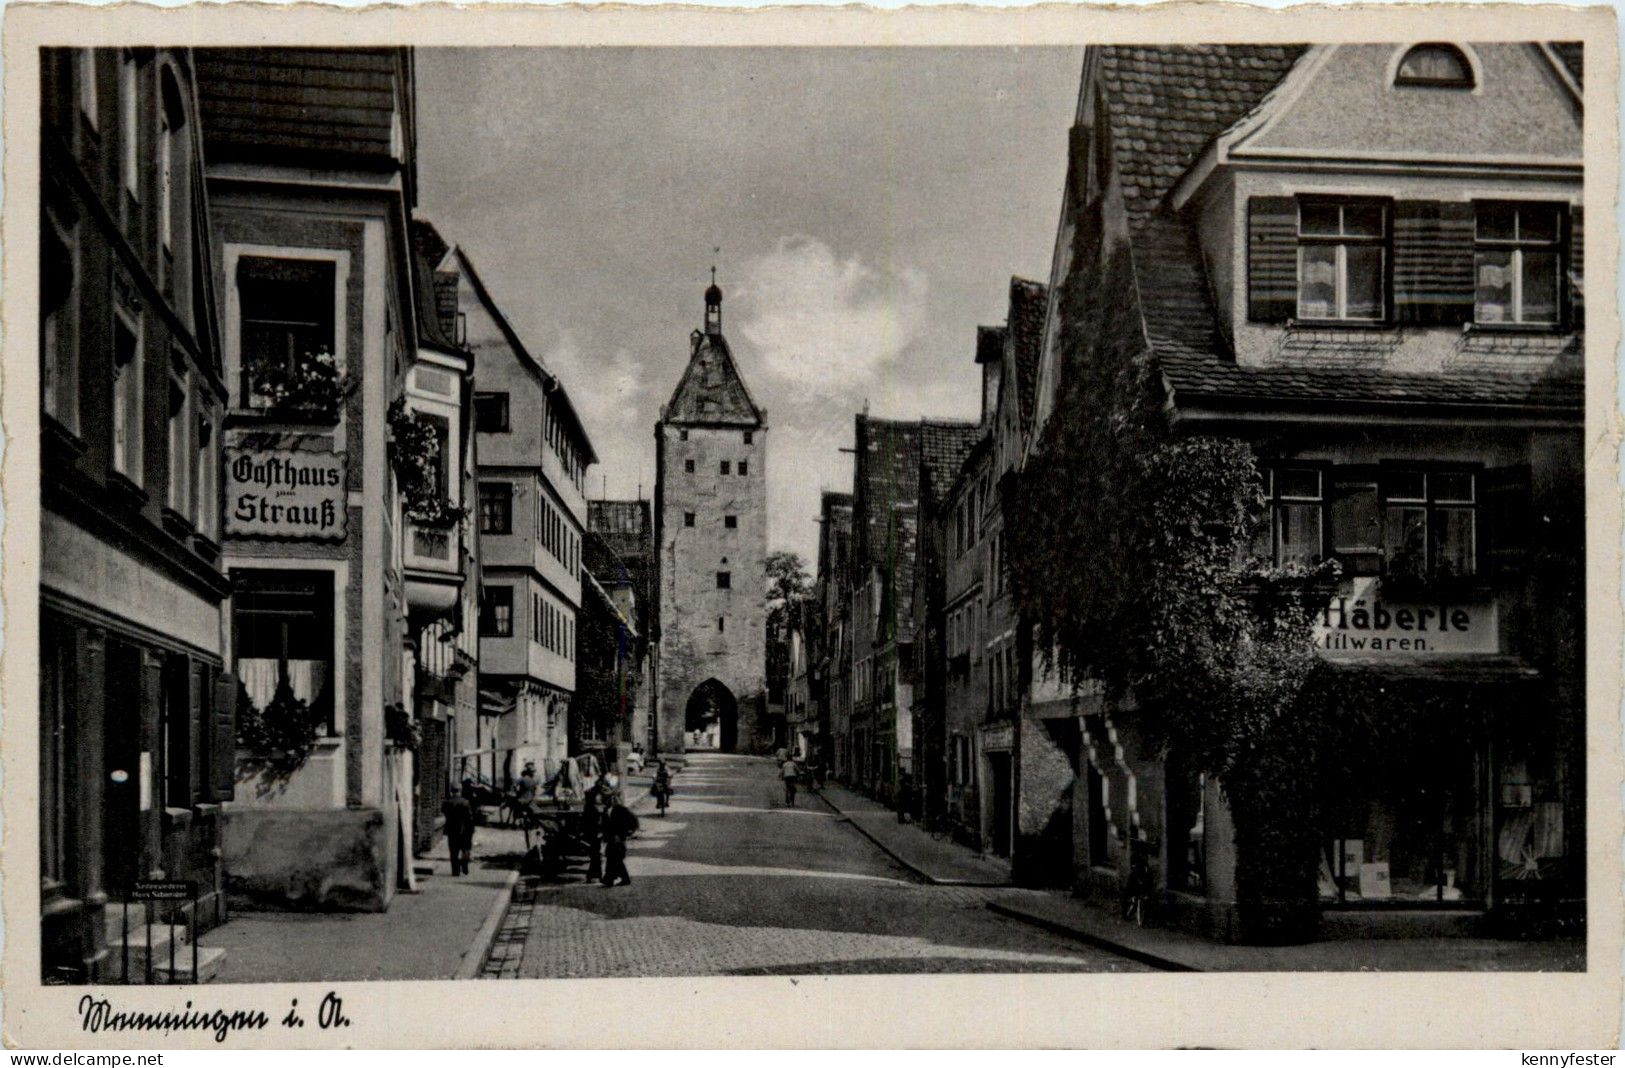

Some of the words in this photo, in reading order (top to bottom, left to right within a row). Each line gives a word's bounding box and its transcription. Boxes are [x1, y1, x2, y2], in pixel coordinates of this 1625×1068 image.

[232, 455, 340, 489] Gasthaus
[235, 493, 336, 531] Strauß
[1323, 597, 1470, 632] Häberle
